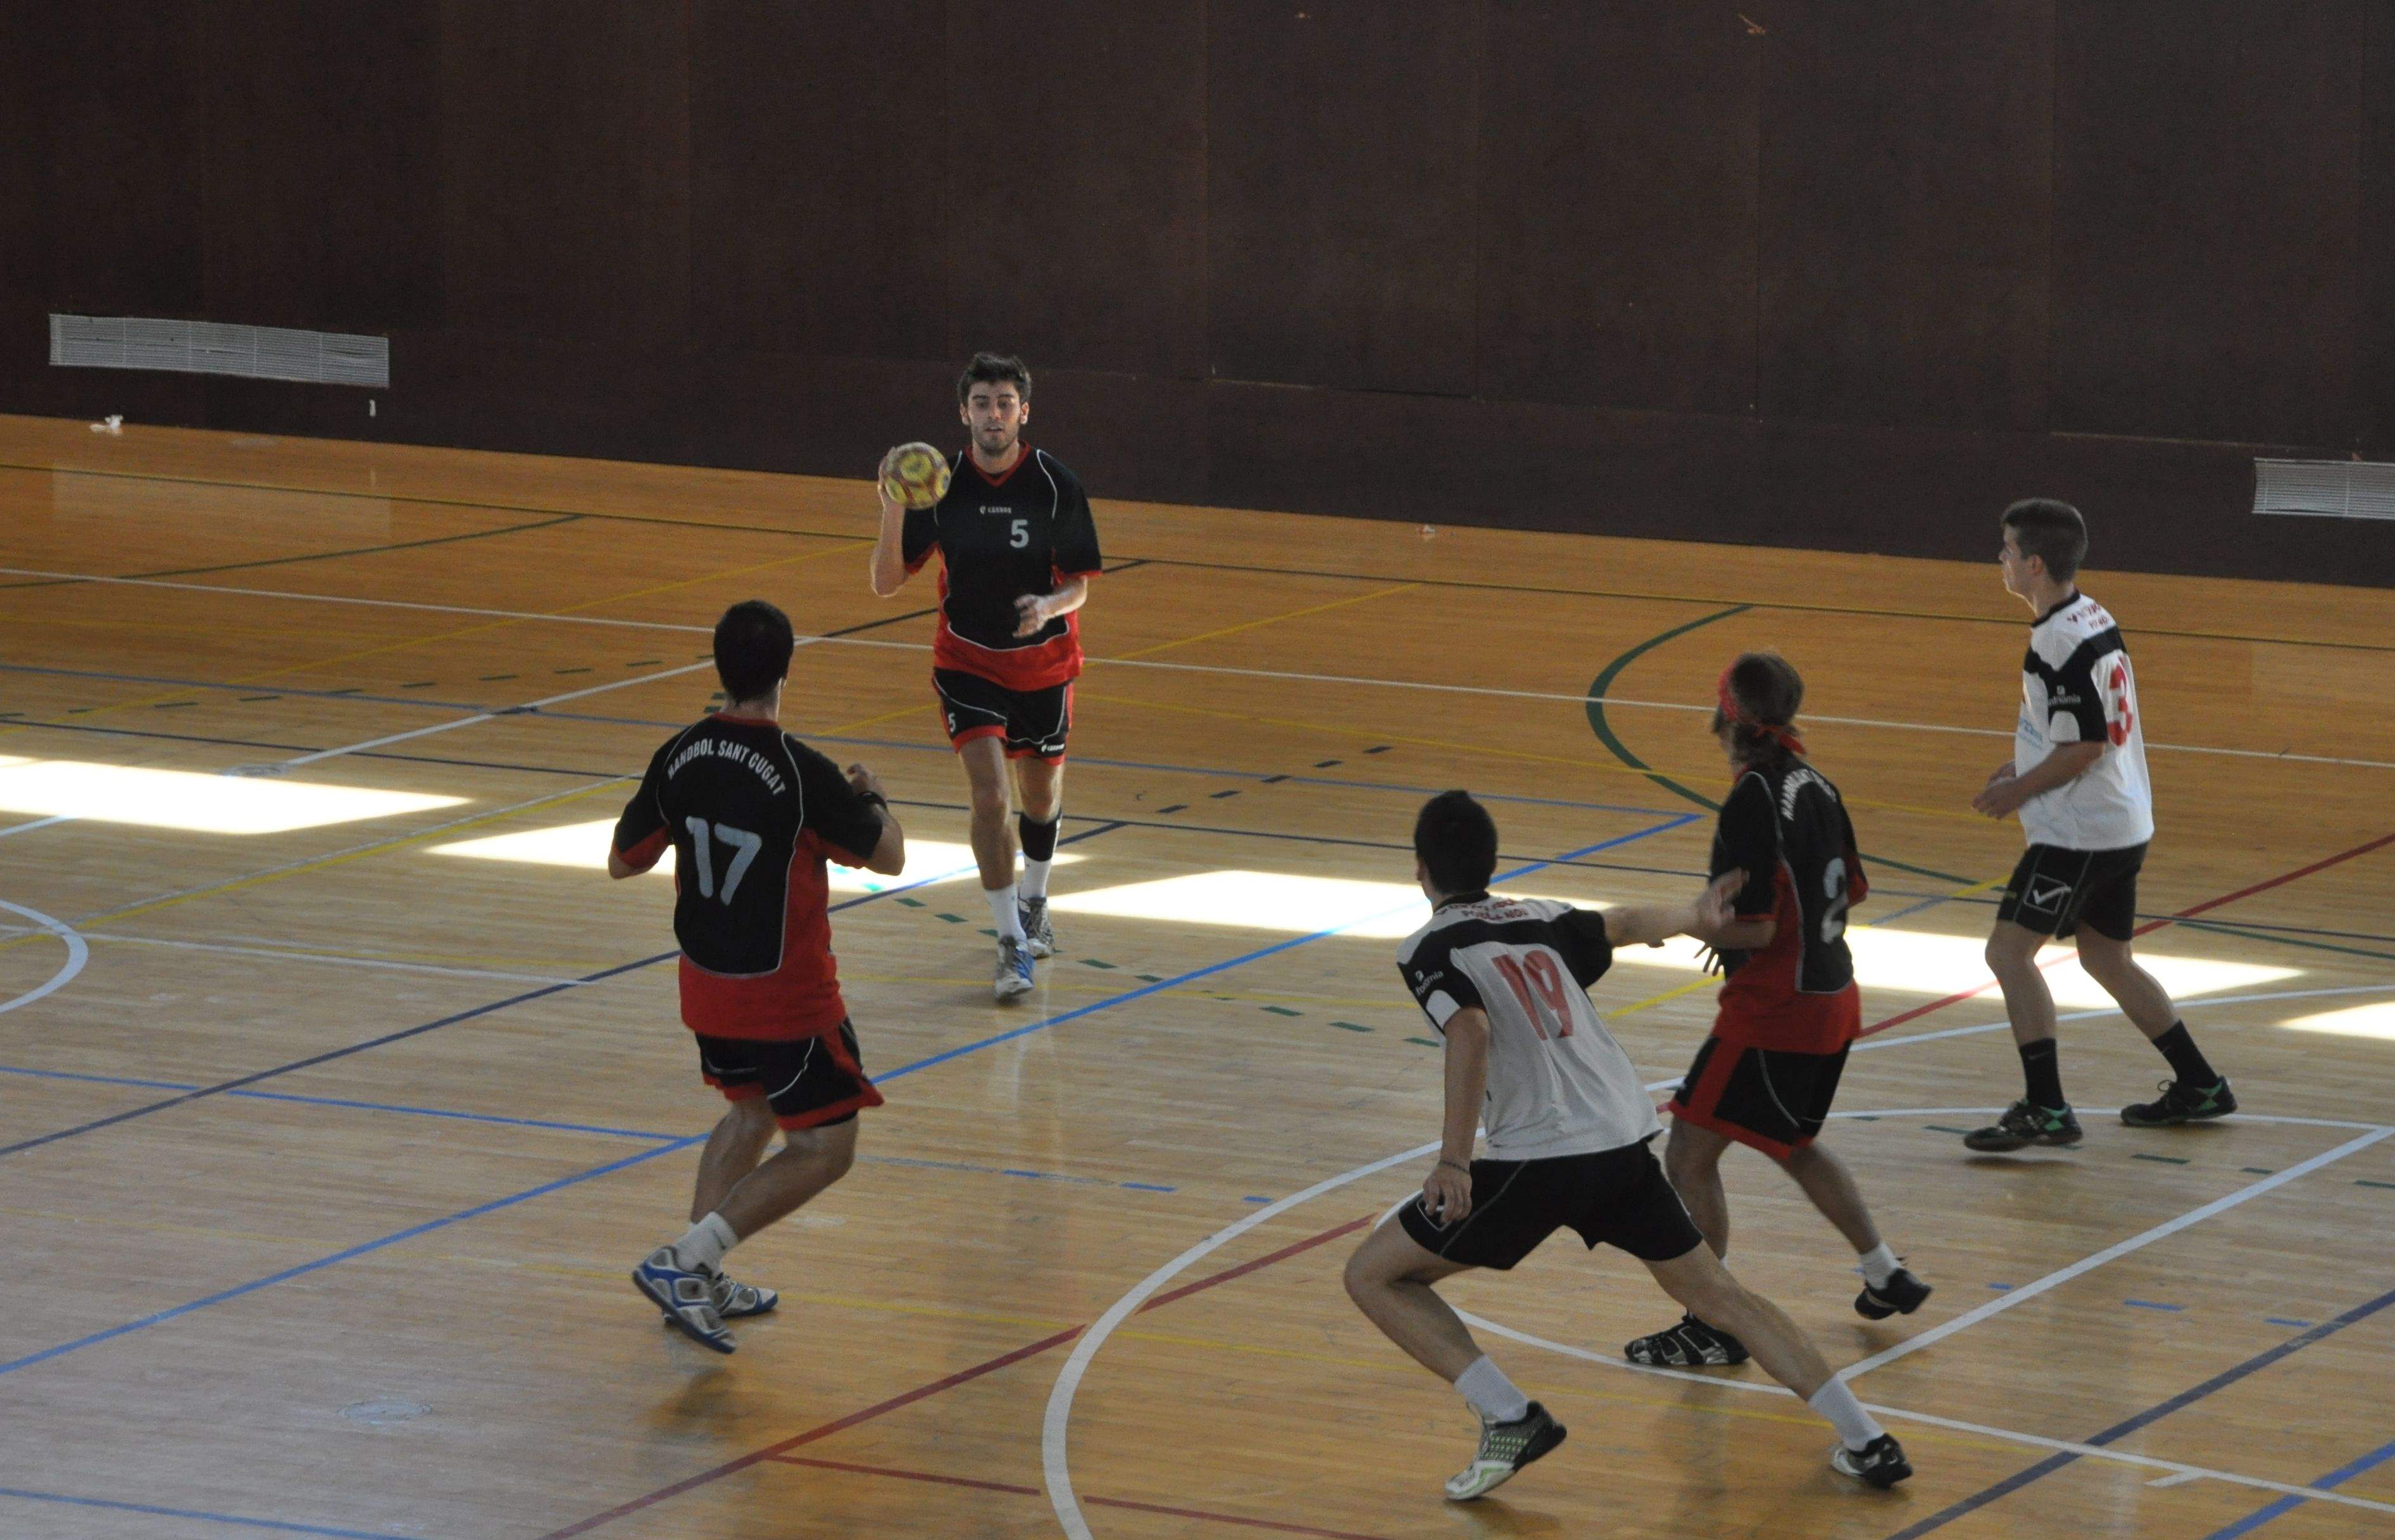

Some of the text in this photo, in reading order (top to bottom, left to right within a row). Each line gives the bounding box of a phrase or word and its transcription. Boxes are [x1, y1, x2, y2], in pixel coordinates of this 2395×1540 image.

[1010, 519, 1029, 548] 5
[668, 738, 786, 795] HANDBOL SANT CUGAT
[685, 815, 762, 905] 17
[1491, 949, 1573, 1041] 19
